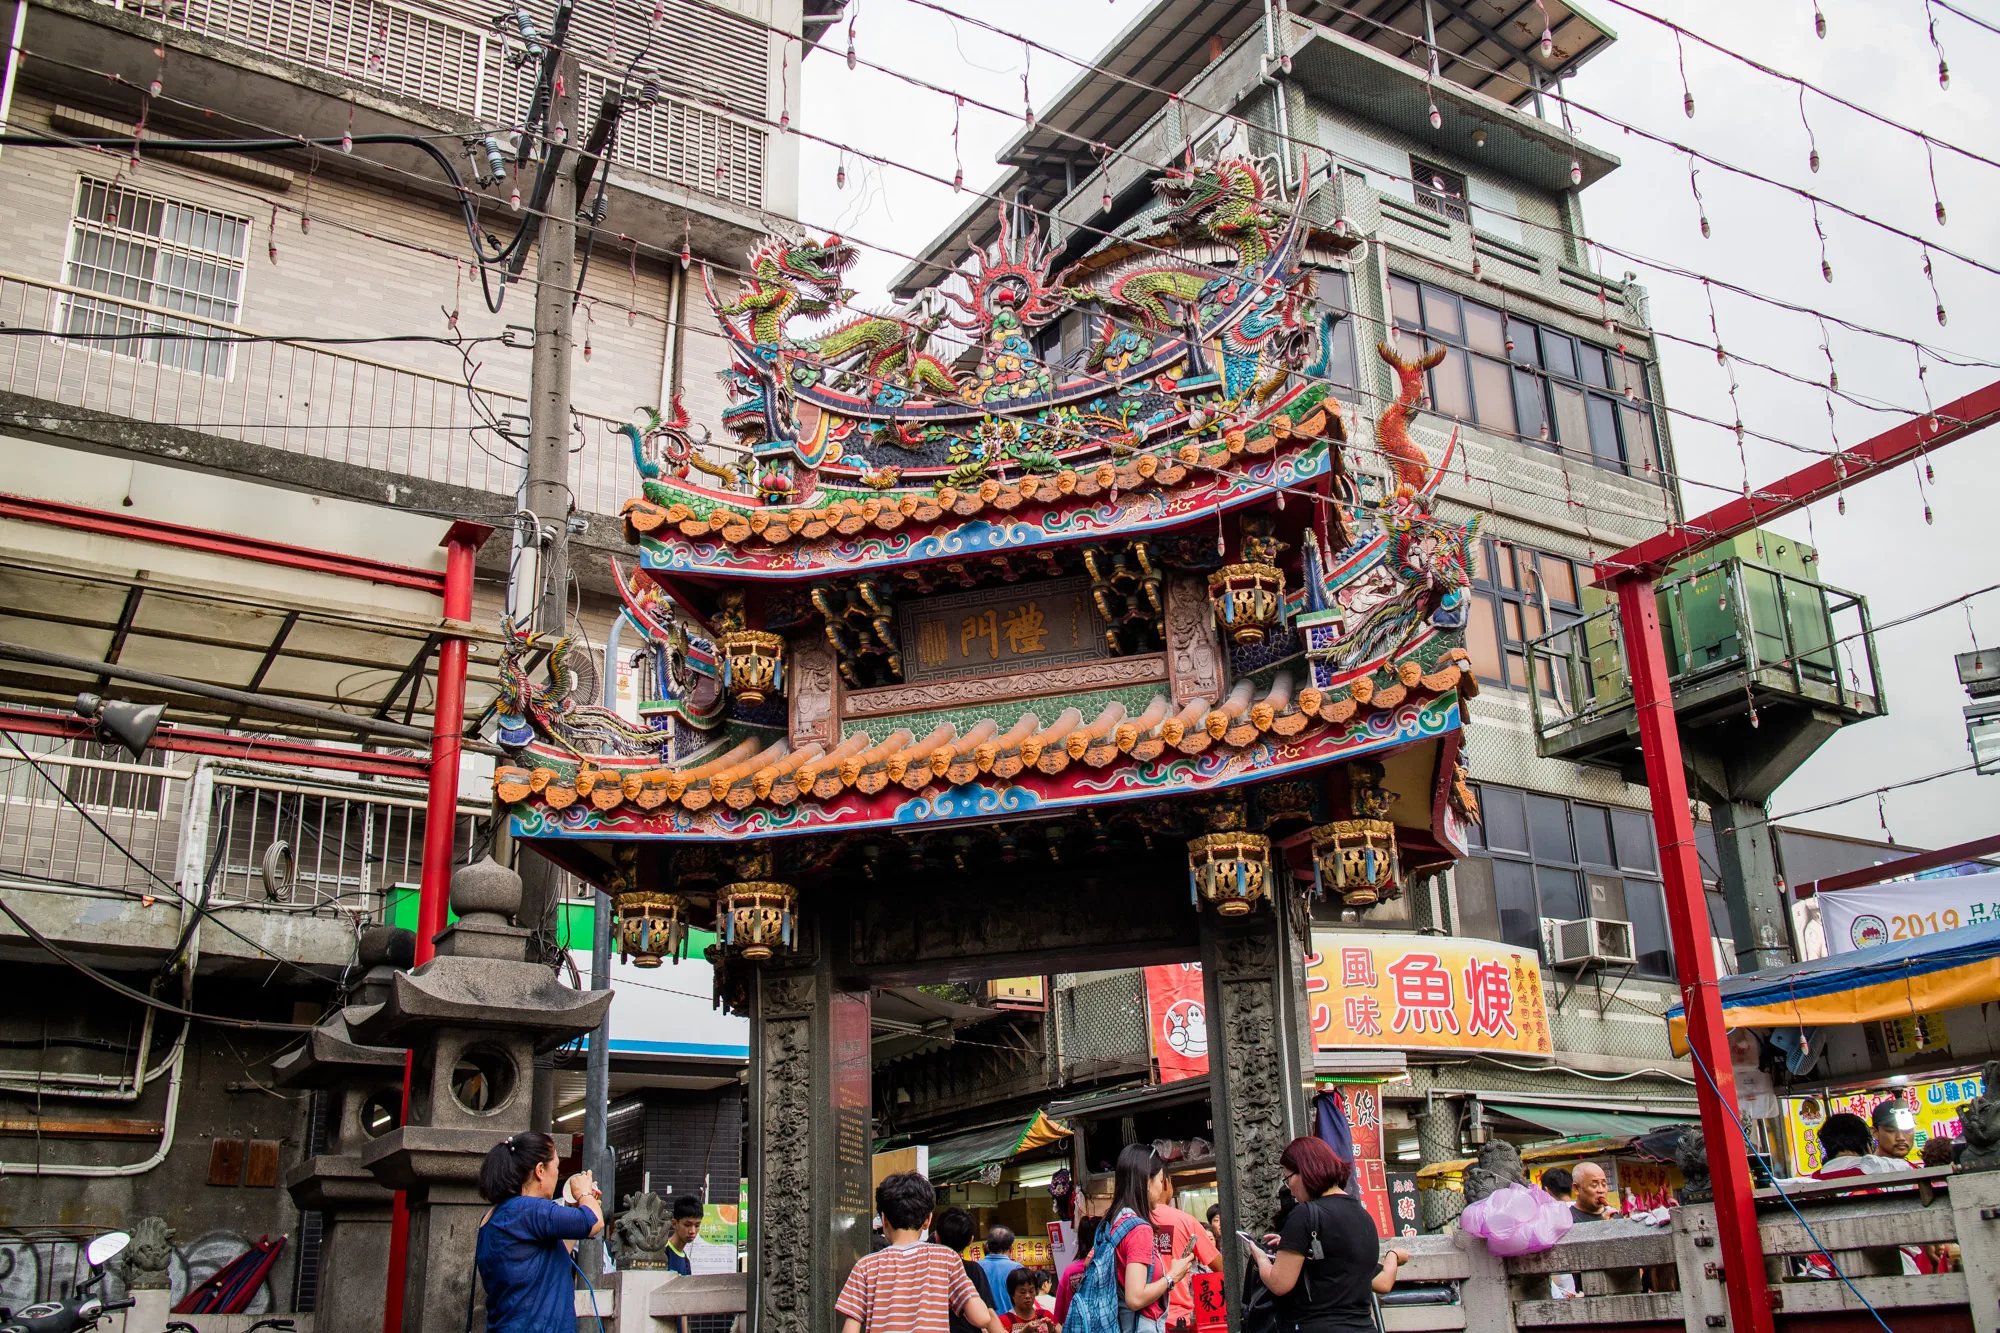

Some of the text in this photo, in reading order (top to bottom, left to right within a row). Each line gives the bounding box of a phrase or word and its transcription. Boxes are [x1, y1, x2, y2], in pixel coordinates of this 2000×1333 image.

[1891, 909, 1960, 941] 2019
[1832, 1086, 1921, 1120] 山豬肉腸
